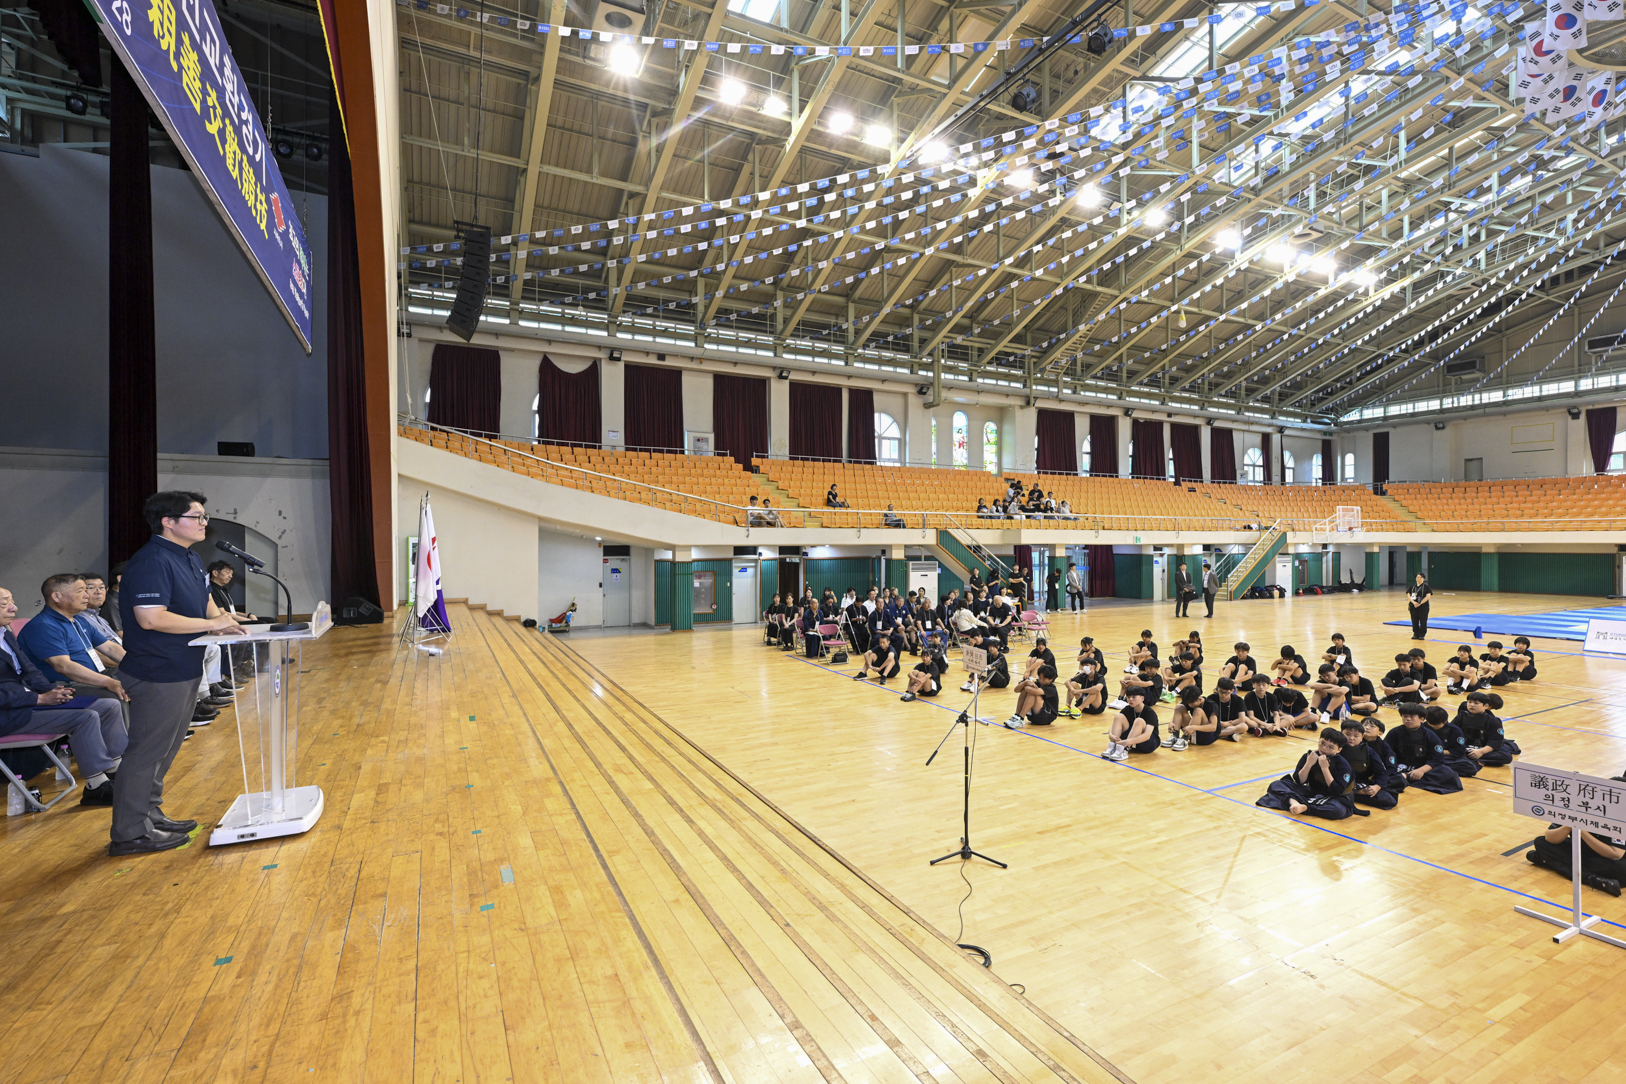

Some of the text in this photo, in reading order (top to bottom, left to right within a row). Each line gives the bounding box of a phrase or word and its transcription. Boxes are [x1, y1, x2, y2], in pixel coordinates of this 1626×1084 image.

[1530, 774, 1621, 805] 議政府市
[1543, 793, 1606, 817] 의정부시
[1547, 810, 1622, 834] 의정부시체육회
